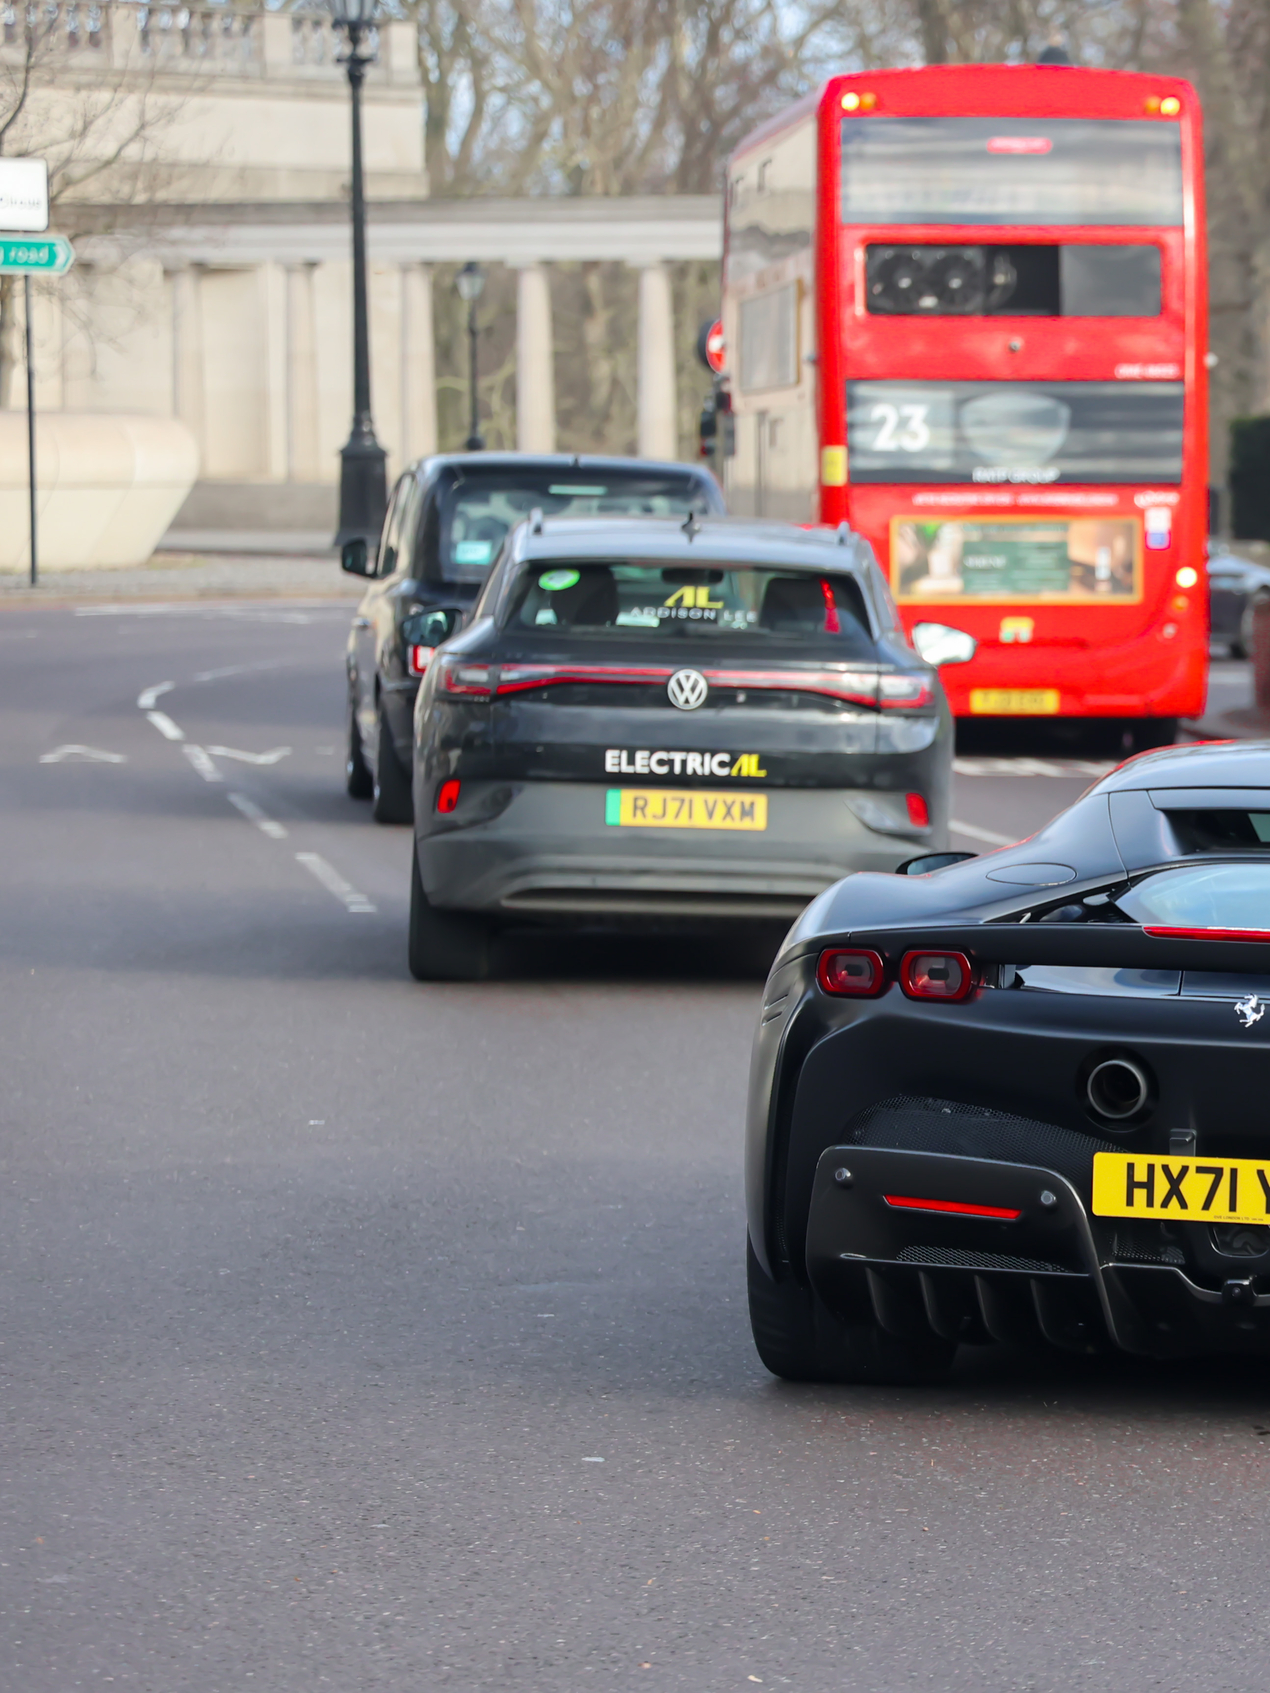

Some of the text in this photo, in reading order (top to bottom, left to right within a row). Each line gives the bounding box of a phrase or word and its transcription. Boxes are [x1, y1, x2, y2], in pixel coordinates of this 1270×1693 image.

[9, 245, 49, 264] road
[870, 403, 931, 452] 23
[664, 585, 724, 609] AL
[631, 607, 757, 623] ADDISON LEE
[633, 795, 756, 823] RJ71 VXM
[1126, 1162, 1239, 1213] HX71
